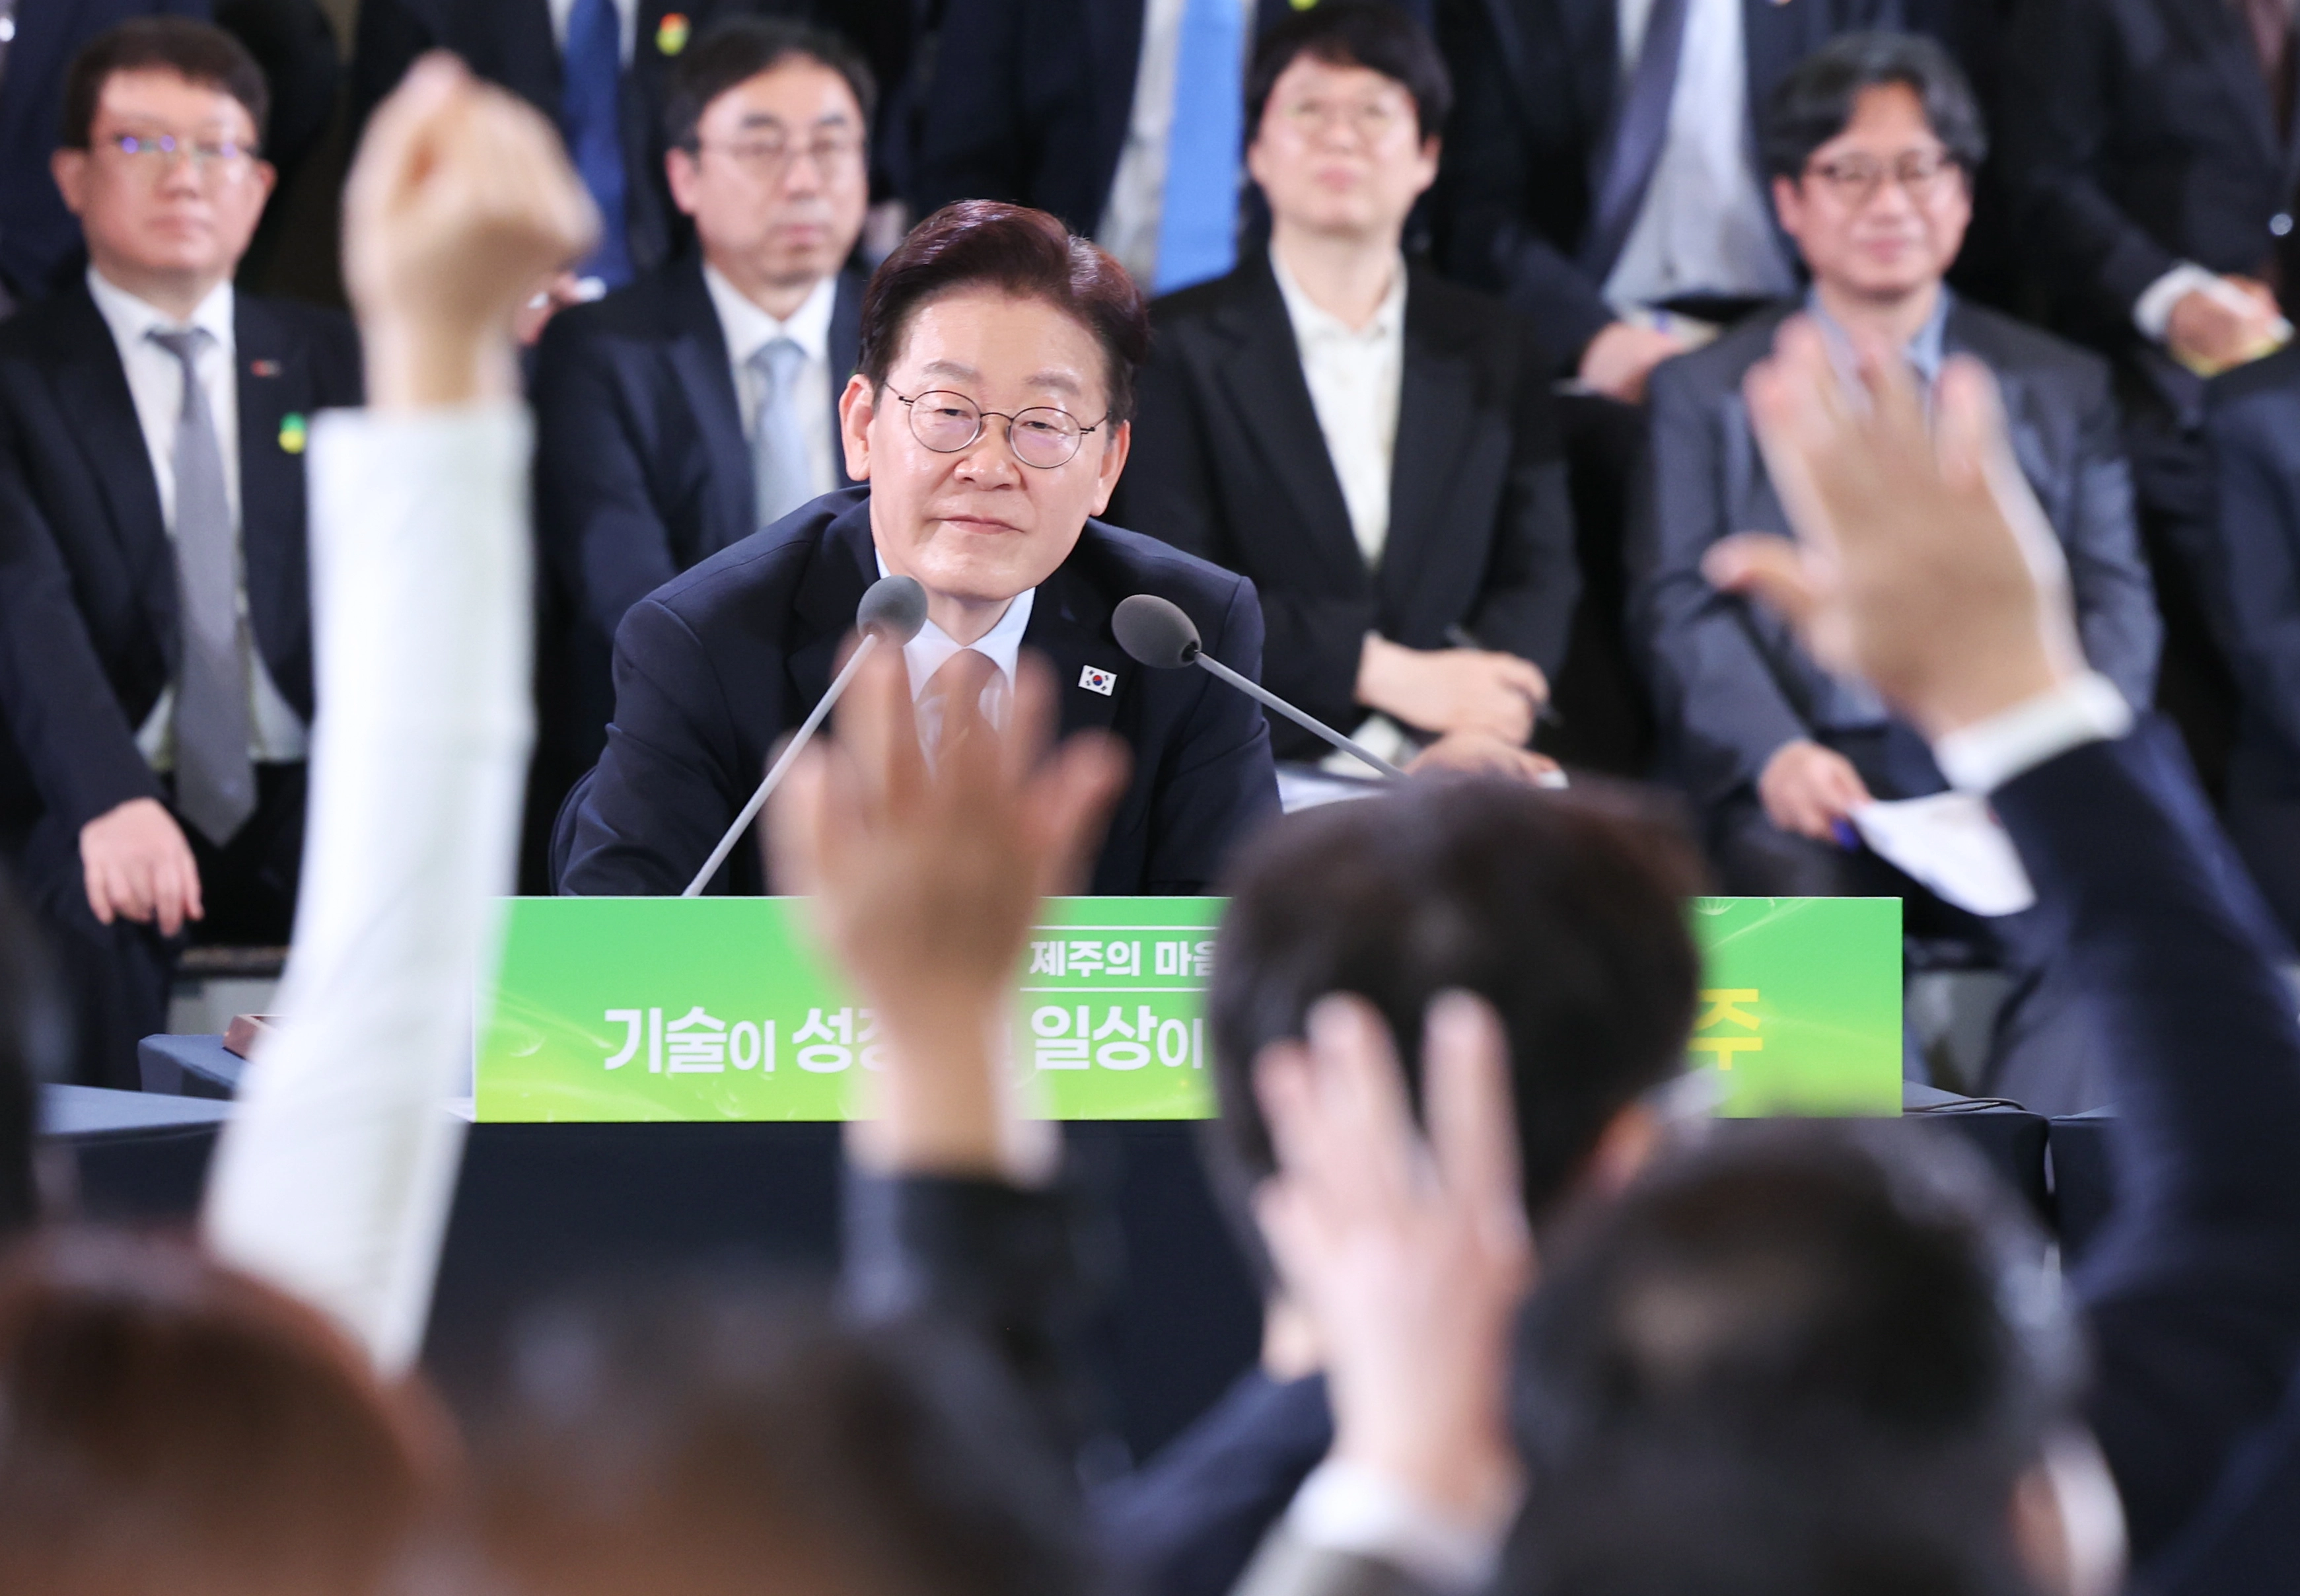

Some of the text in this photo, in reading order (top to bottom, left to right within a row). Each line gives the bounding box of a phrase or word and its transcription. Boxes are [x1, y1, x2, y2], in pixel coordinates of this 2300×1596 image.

[1028, 940, 1141, 978] 제주의
[604, 1005, 775, 1073] 기술이
[1030, 1005, 1203, 1071] 일상이
